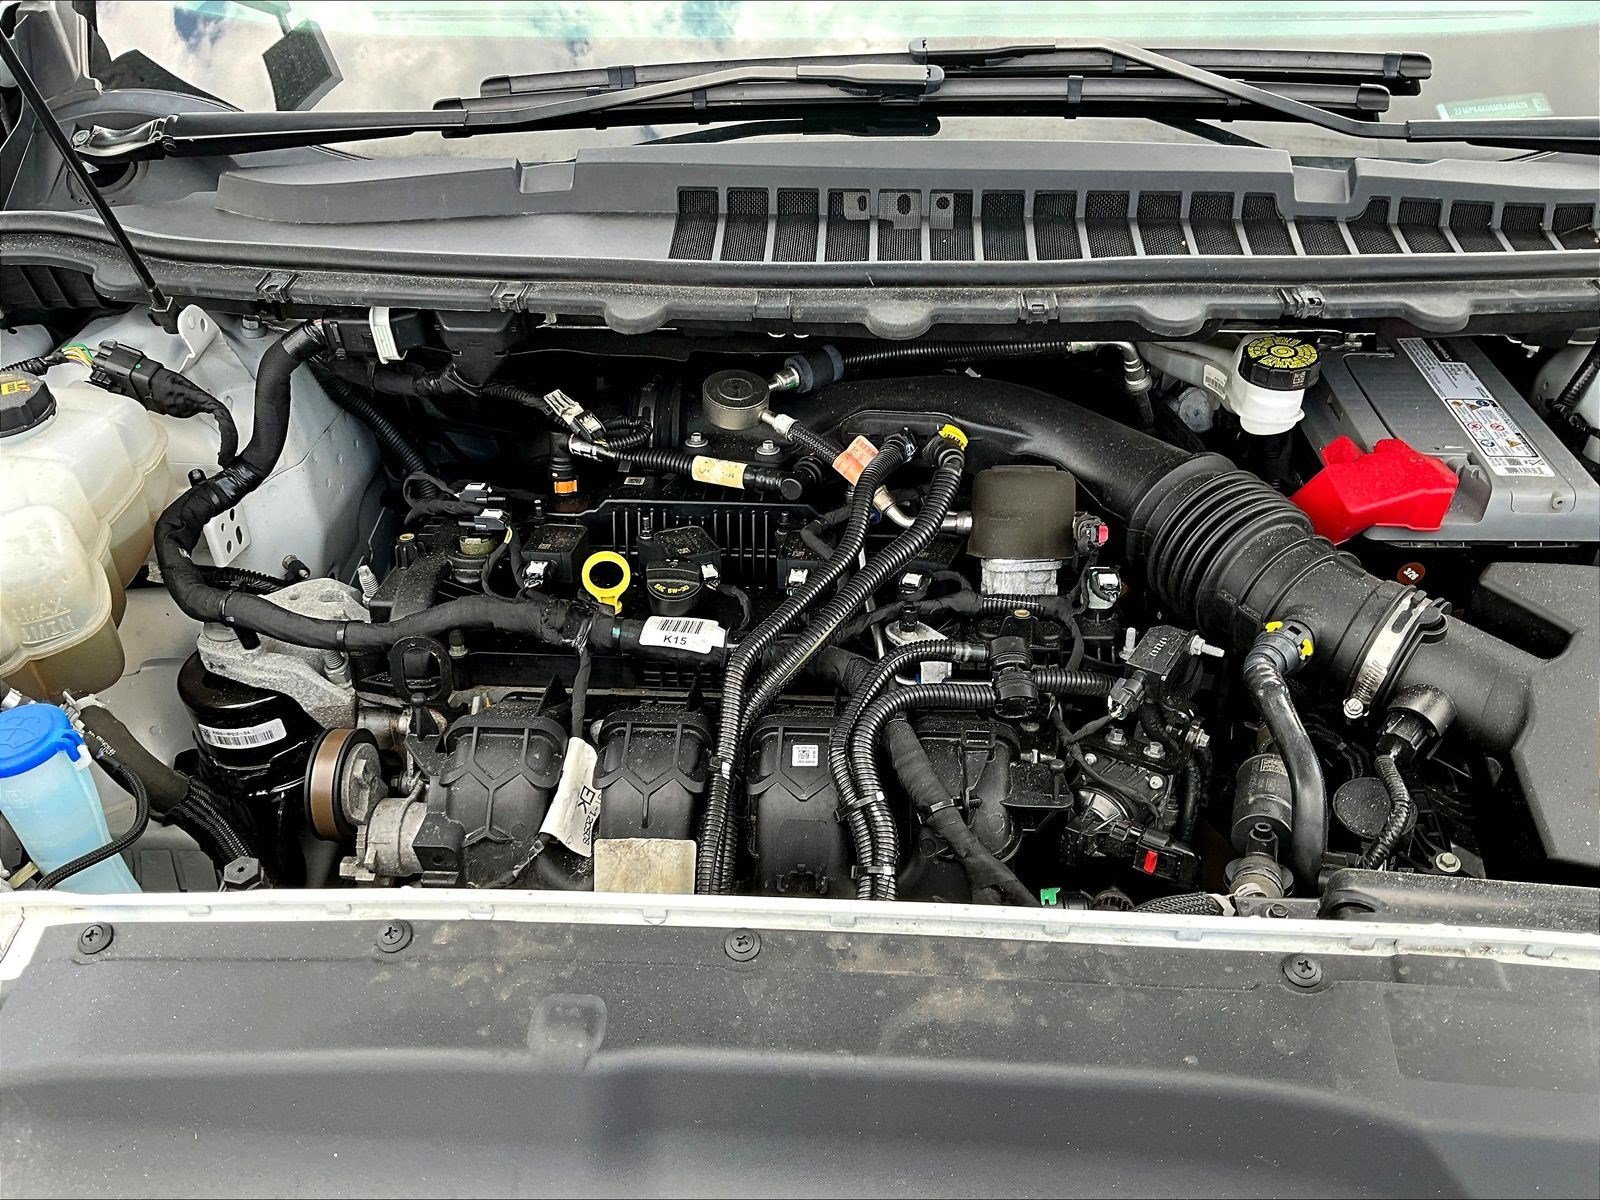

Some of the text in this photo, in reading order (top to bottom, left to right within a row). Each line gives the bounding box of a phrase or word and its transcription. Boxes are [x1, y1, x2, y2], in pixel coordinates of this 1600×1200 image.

[19, 597, 68, 621] MAX
[30, 614, 77, 640] MIN
[663, 635, 688, 646] K15
[577, 784, 596, 815] EK
